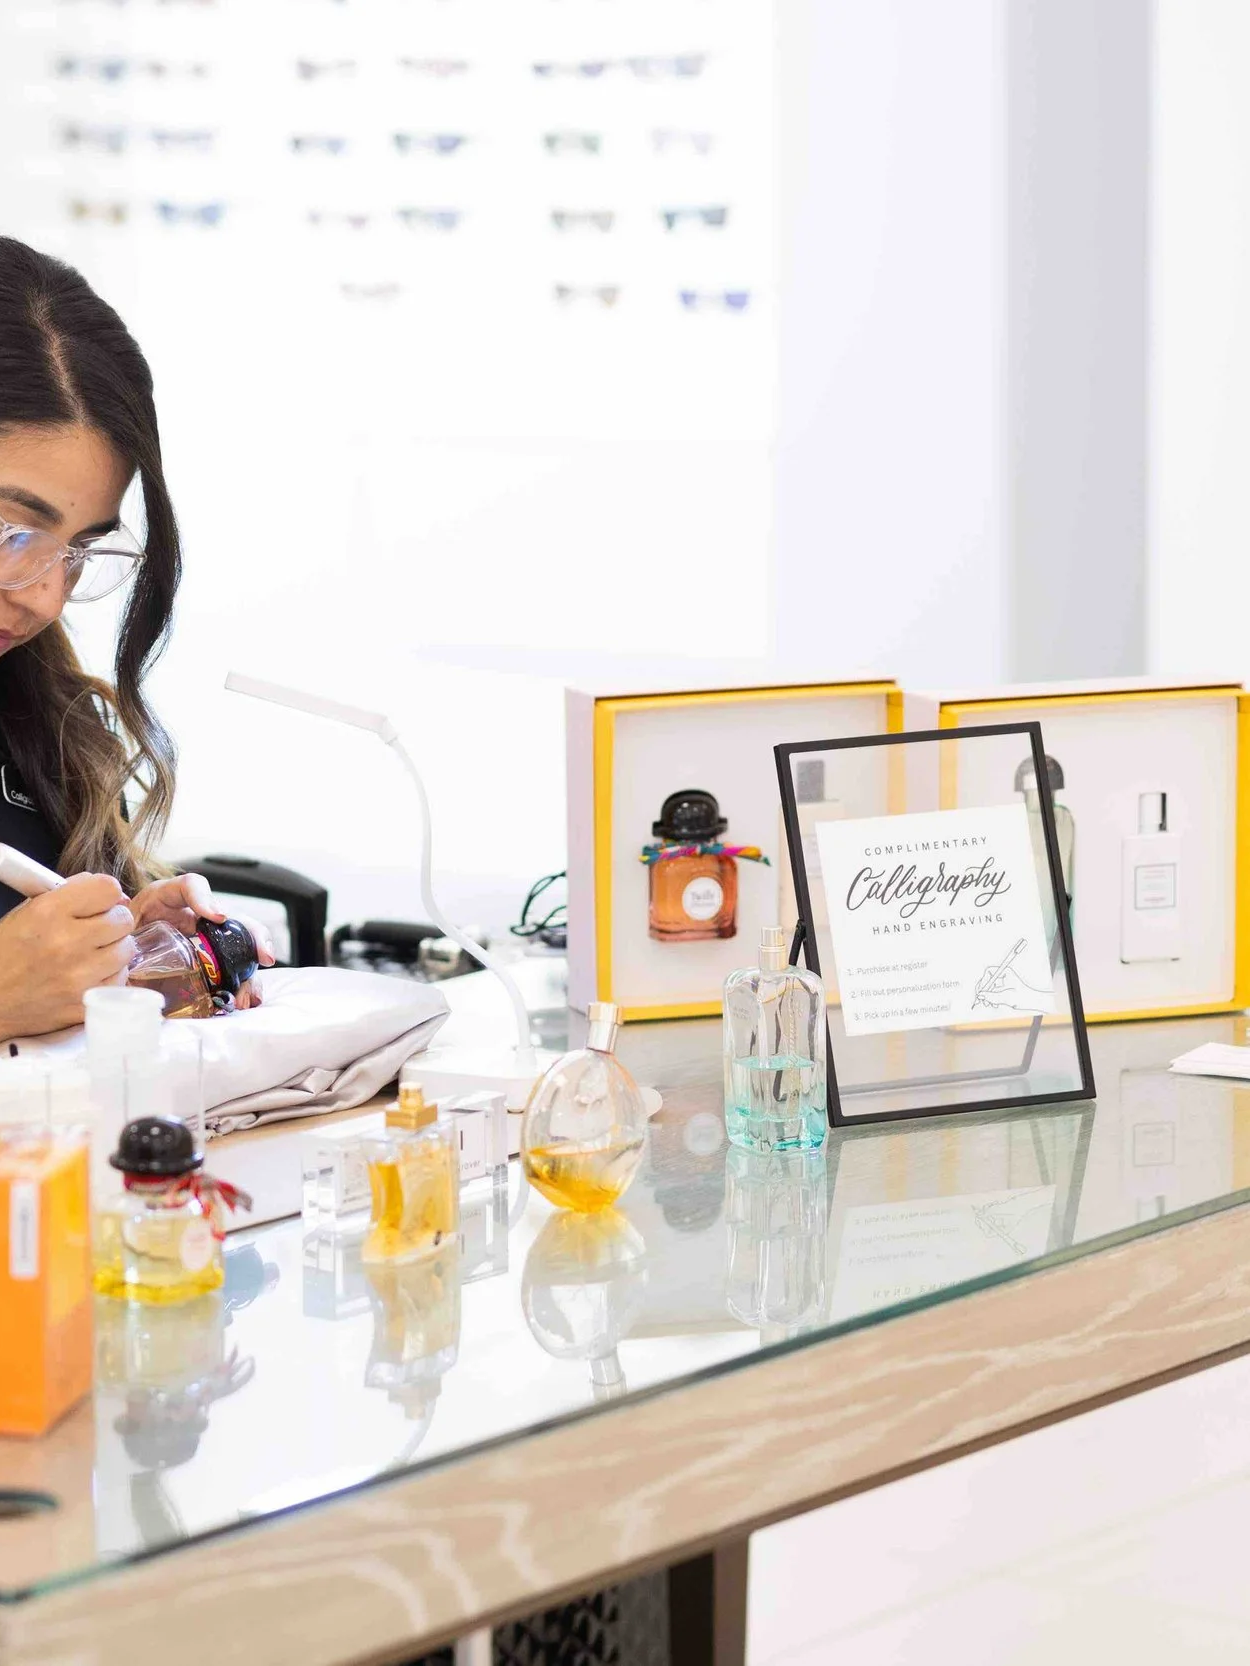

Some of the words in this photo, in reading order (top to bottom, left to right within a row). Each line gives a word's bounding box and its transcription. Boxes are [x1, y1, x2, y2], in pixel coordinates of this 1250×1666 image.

[864, 836, 987, 856] COMPLIMENTARY
[846, 856, 1011, 919] Calligraphy
[872, 922, 911, 935] HAND
[920, 913, 1003, 930] ENGRAVING
[847, 968, 854, 976] 1.
[857, 964, 890, 975] Purchase
[891, 964, 899, 972] at
[900, 961, 928, 972] register
[860, 989, 871, 997] Fill
[872, 988, 885, 996] out
[886, 982, 942, 996] personalization
[942, 980, 960, 988] form
[854, 1013, 860, 1021] 3.
[864, 1010, 878, 1020] Pick
[881, 1010, 890, 1019] up
[891, 1009, 898, 1017] in
[905, 1007, 918, 1016] few
